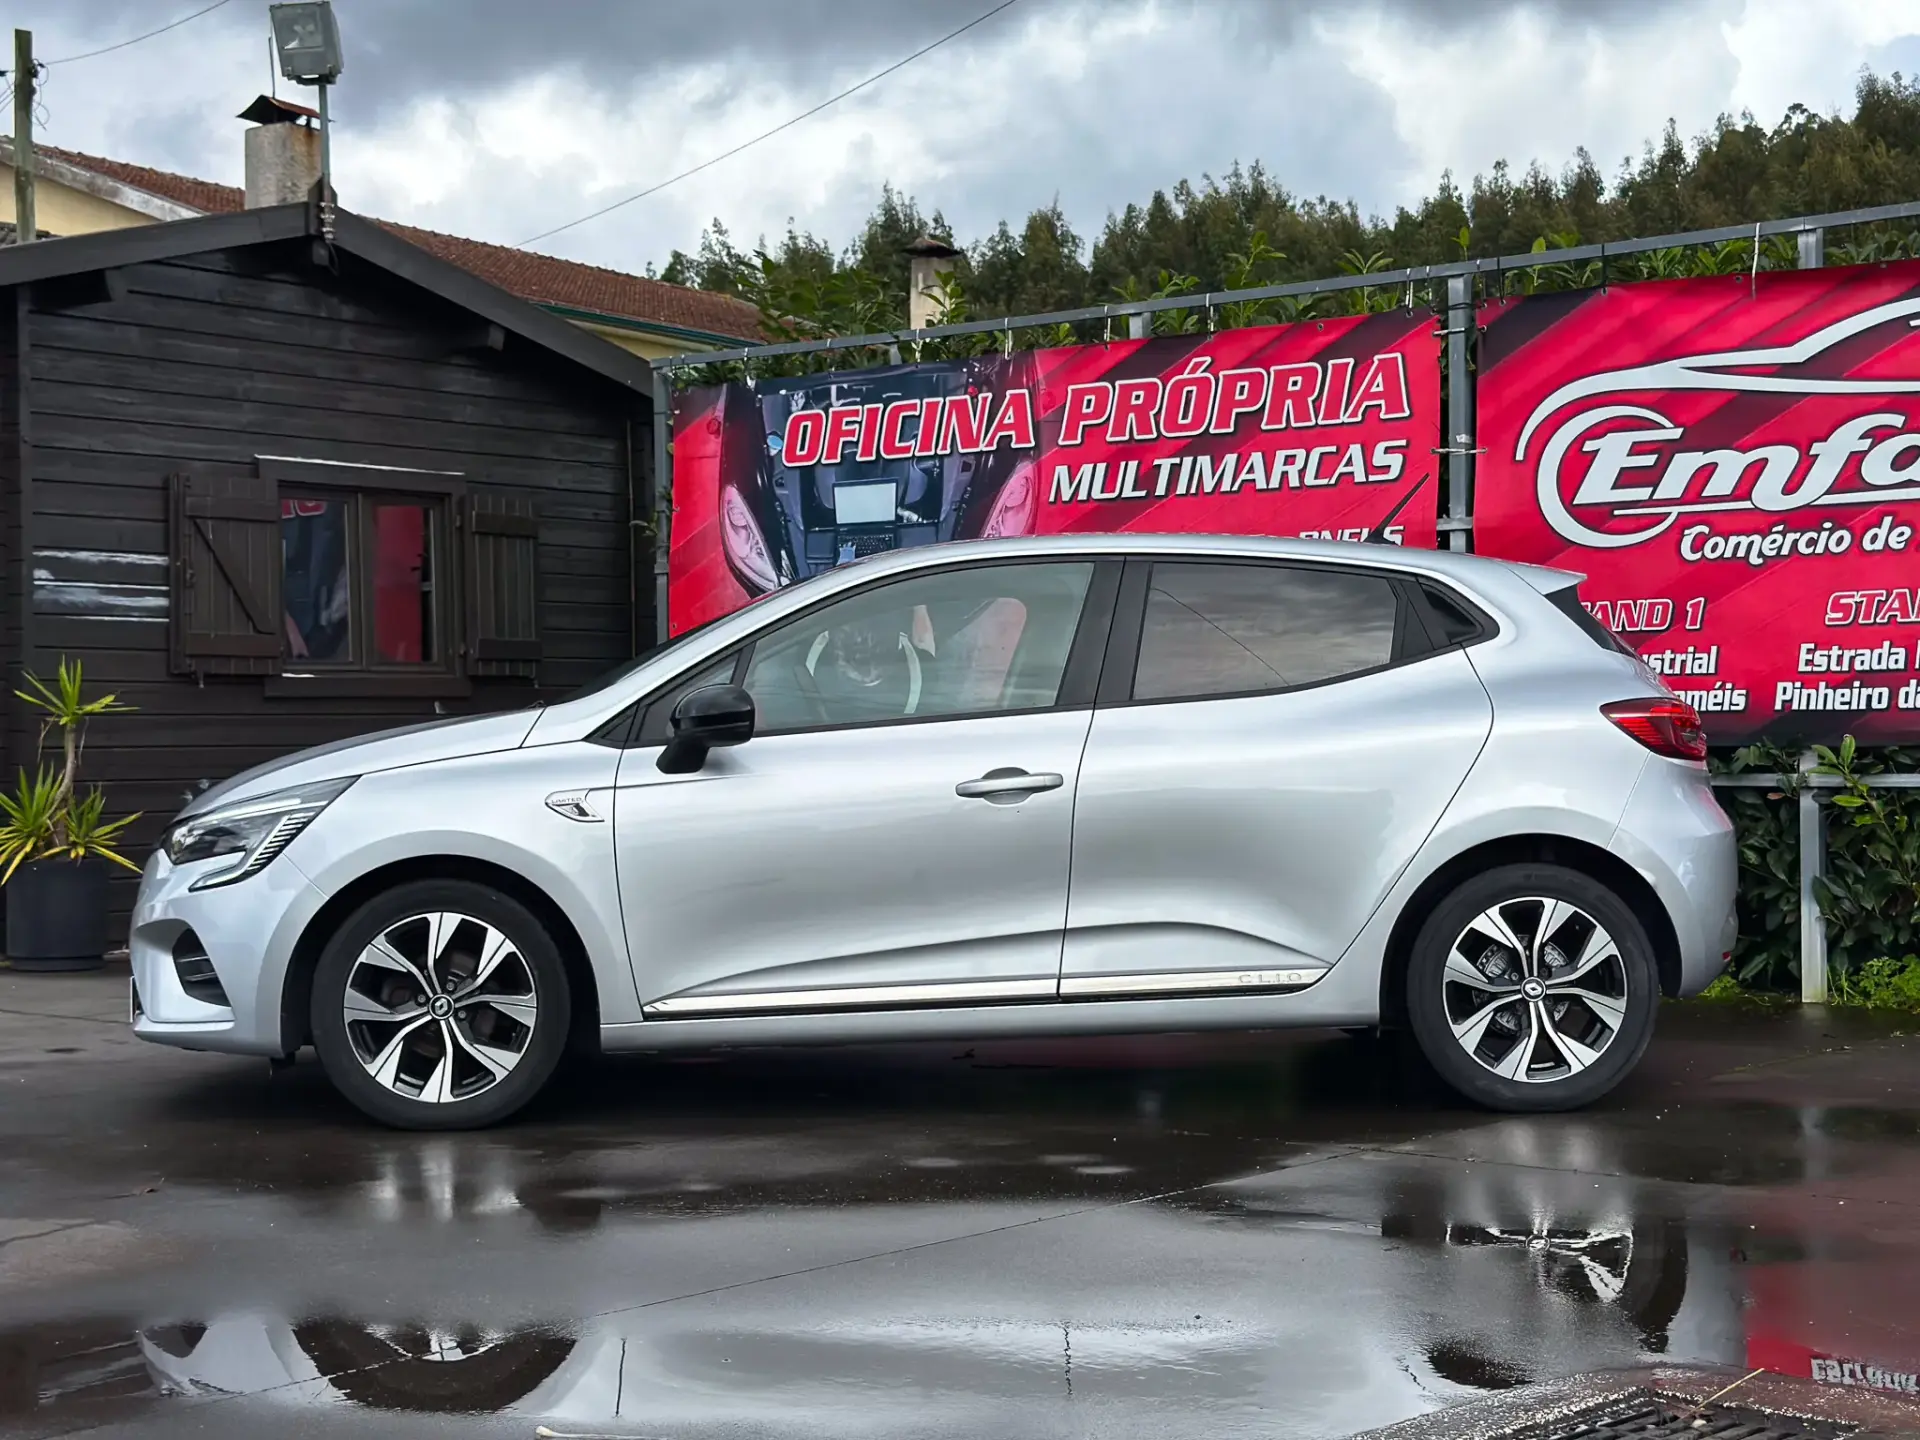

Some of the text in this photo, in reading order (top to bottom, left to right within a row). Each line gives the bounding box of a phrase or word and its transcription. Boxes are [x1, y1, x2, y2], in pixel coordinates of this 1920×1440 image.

[782, 352, 1411, 467] OFICINA PRÓPRIA
[1048, 439, 1407, 503] MULTIMARCAS
[1680, 516, 1912, 566] Comércio de
[1580, 597, 1705, 632] AND 1
[1641, 645, 1718, 675] strial
[1797, 640, 1906, 672] Estrada
[1774, 679, 1920, 711] Pinheiro d
[1238, 972, 1302, 984] CLIO
